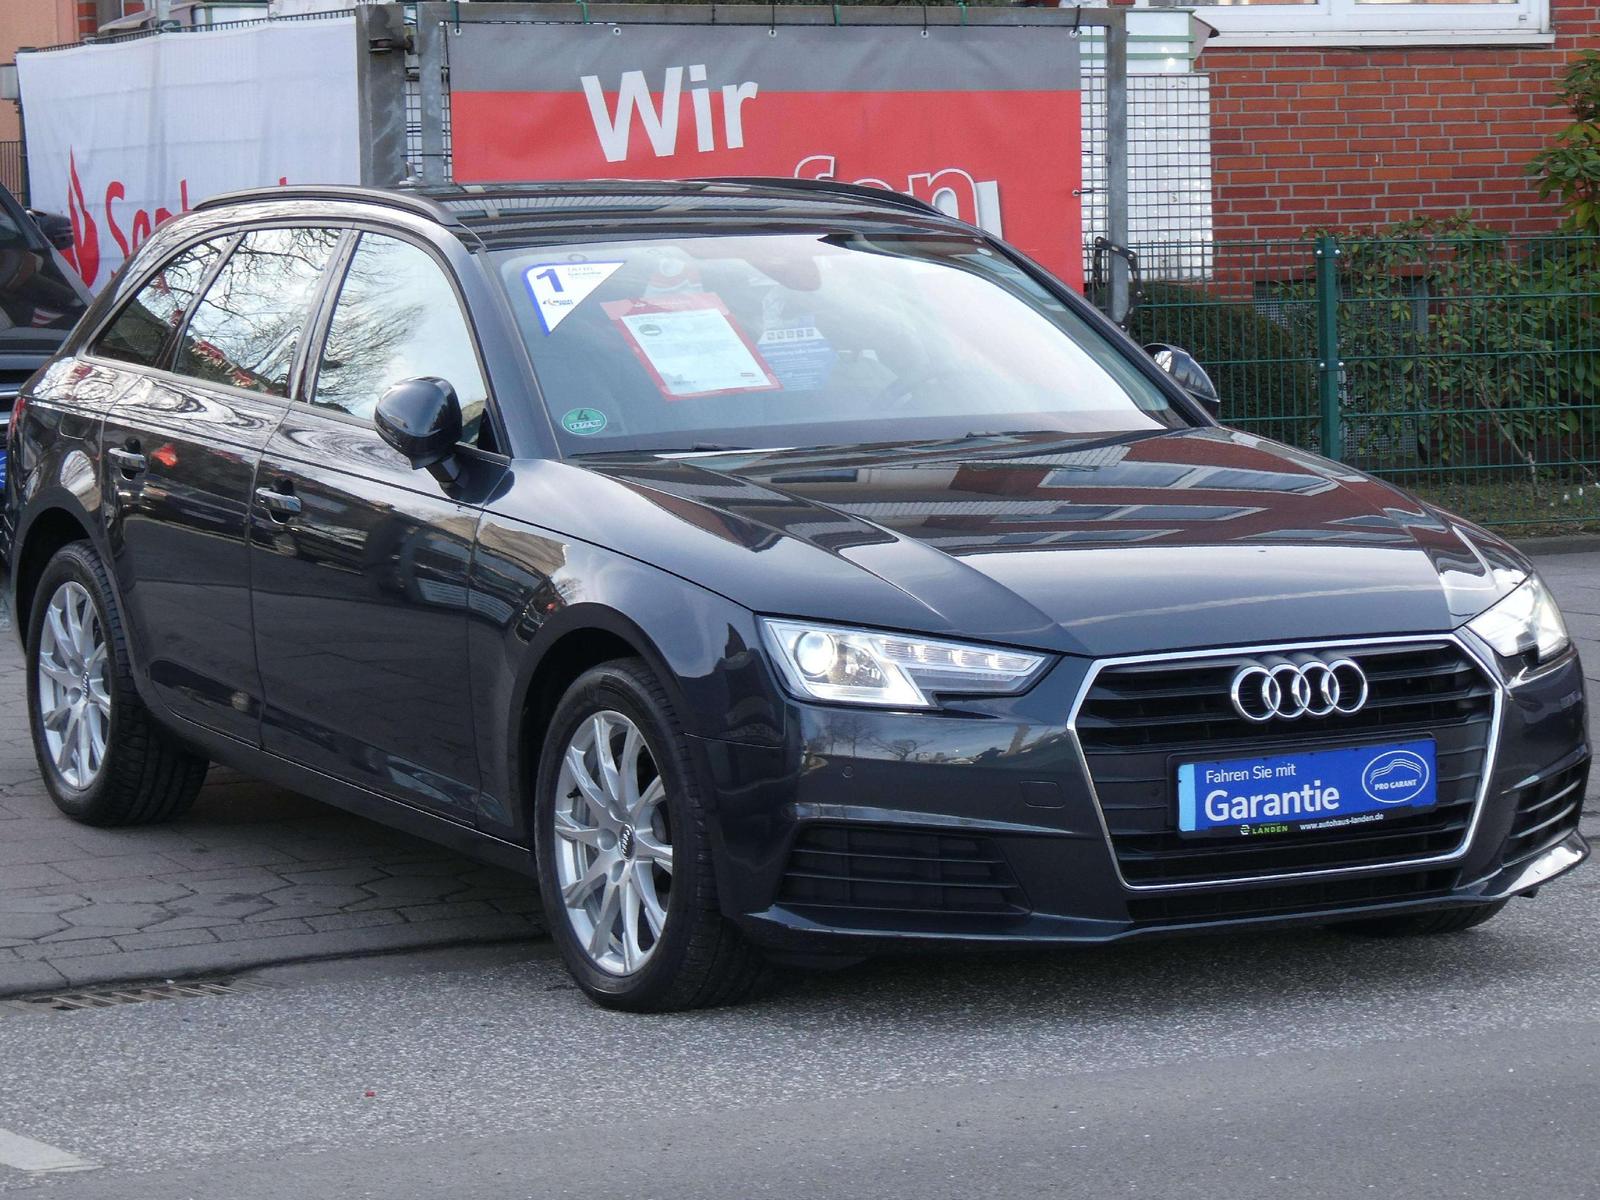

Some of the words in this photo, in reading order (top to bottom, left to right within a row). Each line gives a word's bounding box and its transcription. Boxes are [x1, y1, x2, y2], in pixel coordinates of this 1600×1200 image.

[580, 64, 758, 162] Wir
[536, 268, 564, 293] 1
[577, 409, 589, 421] 4
[1205, 768, 1249, 784] Fahren
[1252, 765, 1272, 781] Sie
[1275, 762, 1296, 777] mit
[1374, 782, 1389, 791] PRO
[1390, 778, 1418, 790] GARANT
[1204, 779, 1340, 822] Garantie
[1252, 825, 1288, 835] LANDEN
[1299, 812, 1384, 831] www.autohaus-landen.de
